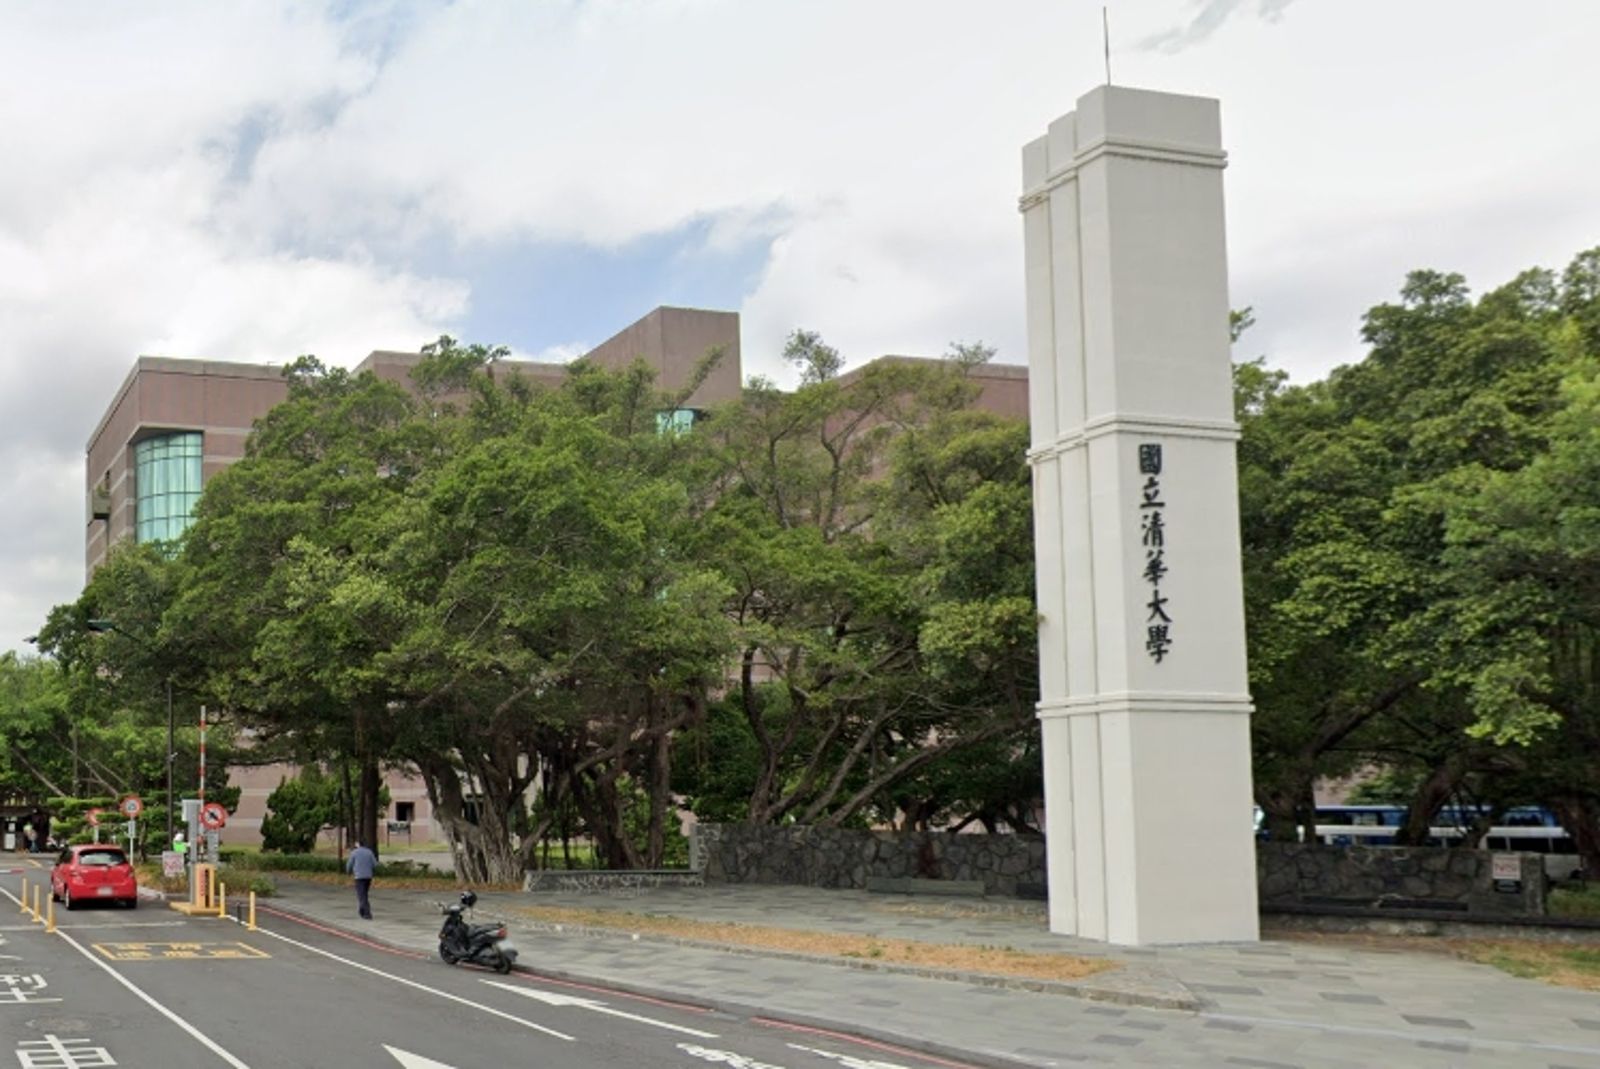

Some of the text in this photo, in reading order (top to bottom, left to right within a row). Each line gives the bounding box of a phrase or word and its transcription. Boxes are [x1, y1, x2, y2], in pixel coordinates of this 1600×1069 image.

[1138, 443, 1173, 664] 國立清華大學
